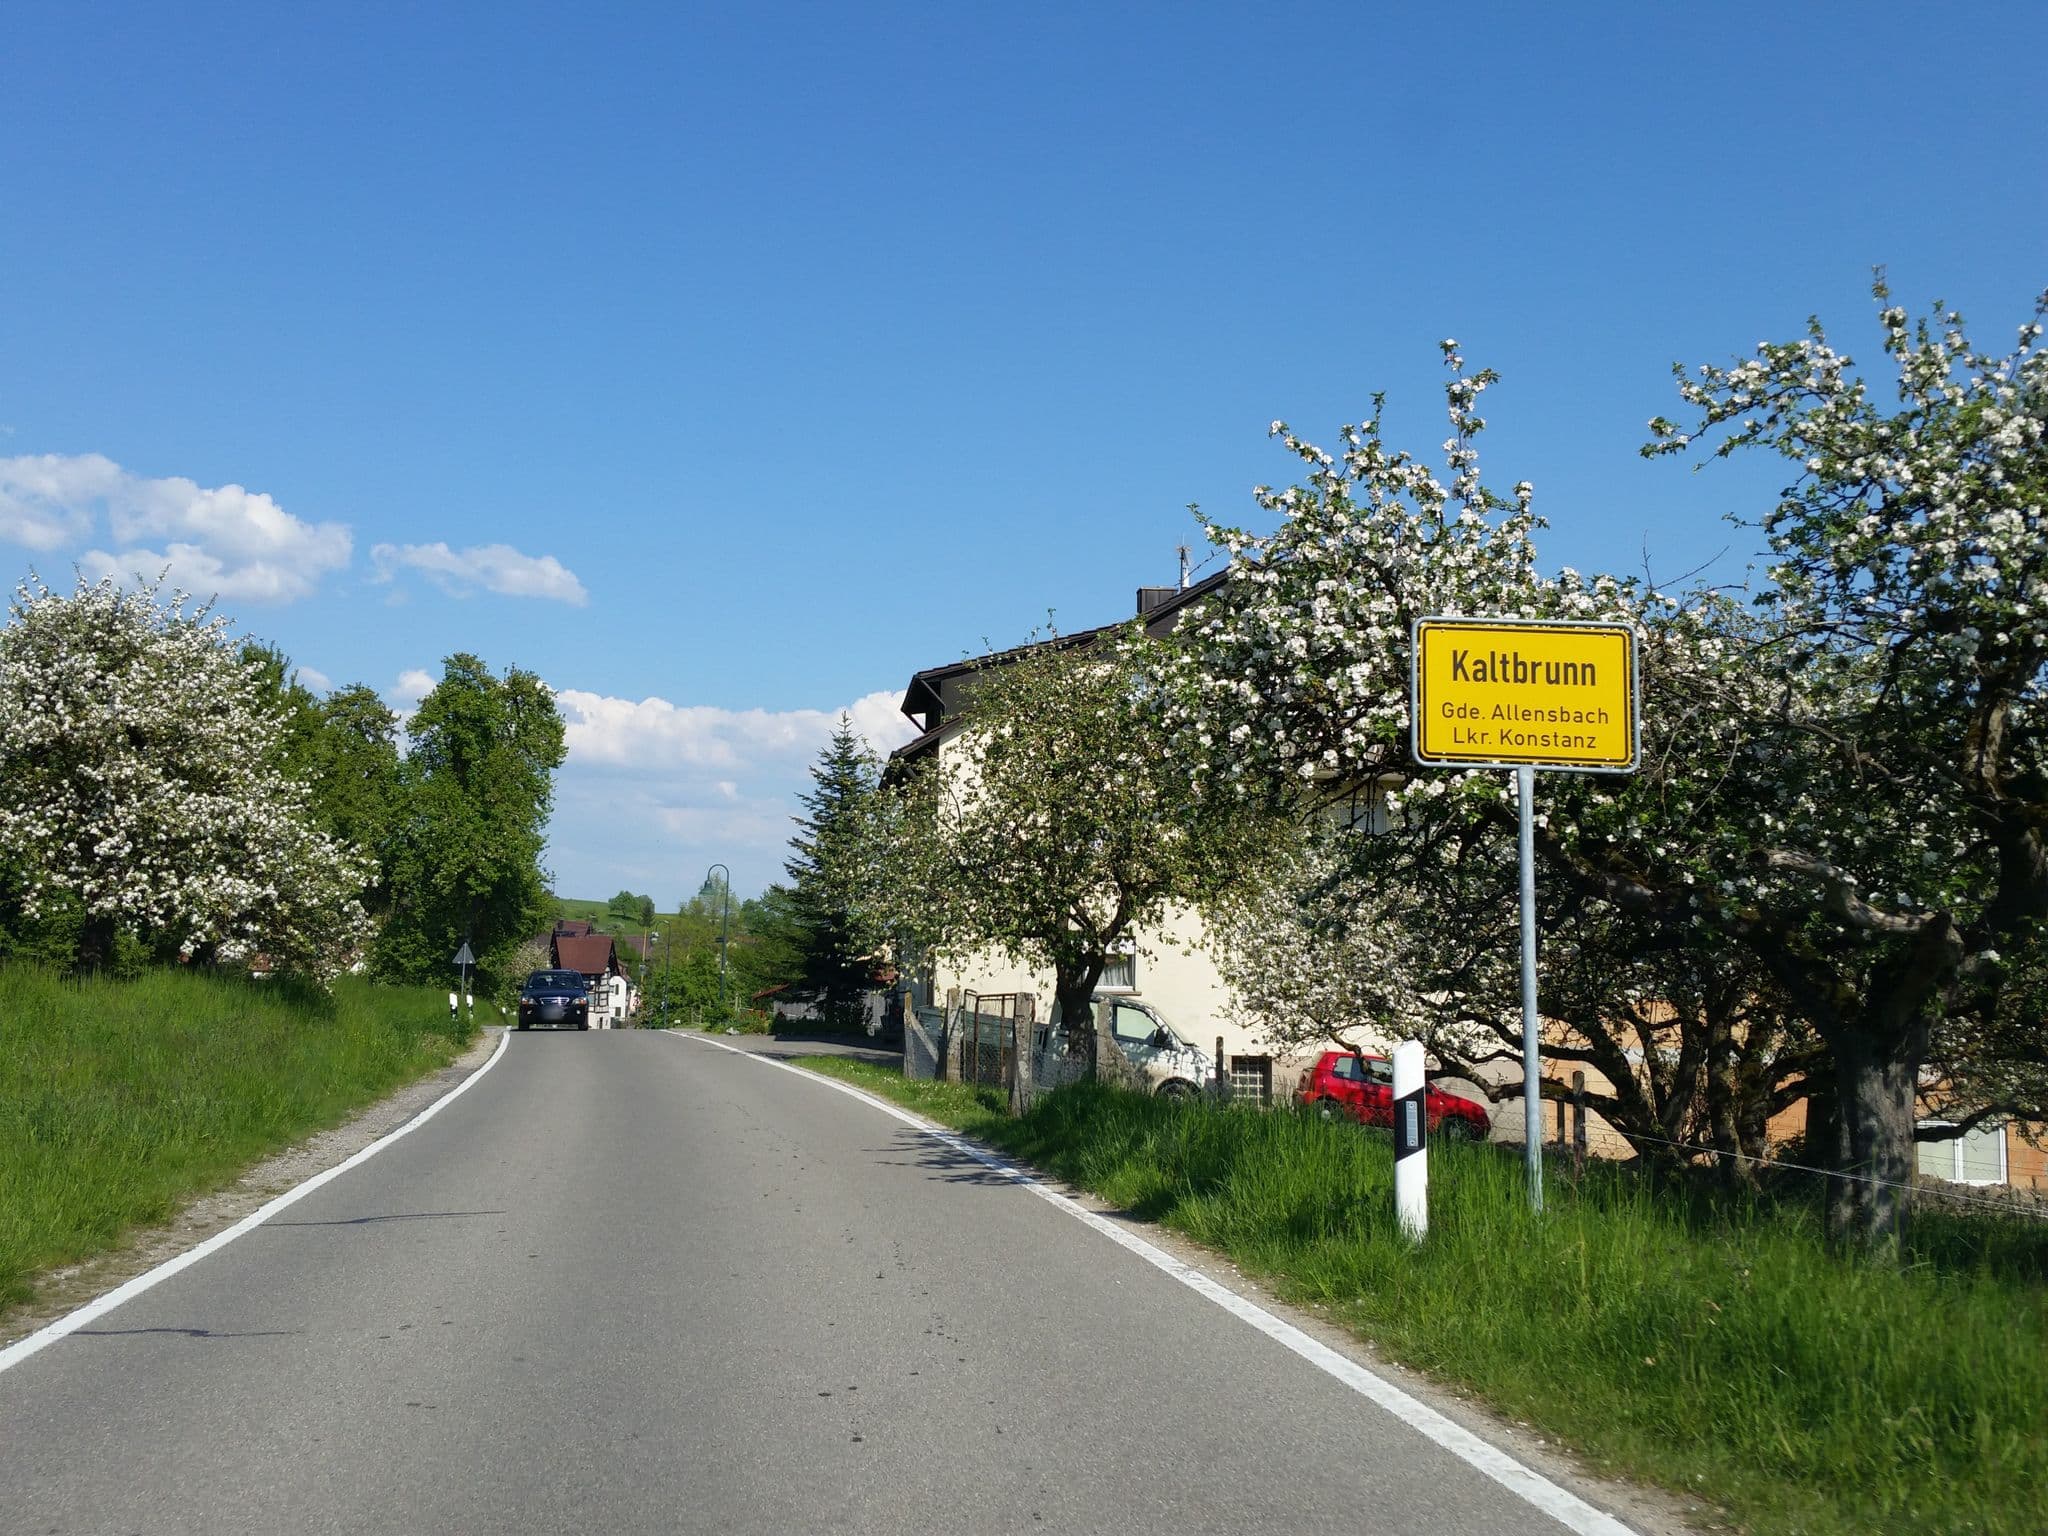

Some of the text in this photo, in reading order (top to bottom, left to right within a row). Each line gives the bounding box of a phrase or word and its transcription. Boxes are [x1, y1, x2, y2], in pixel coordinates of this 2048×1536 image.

[1452, 650, 1596, 686] Kaltbrunn
[1442, 702, 1609, 724] Gde. Allensbach
[1453, 727, 1597, 748] Lkr. Konstanz
